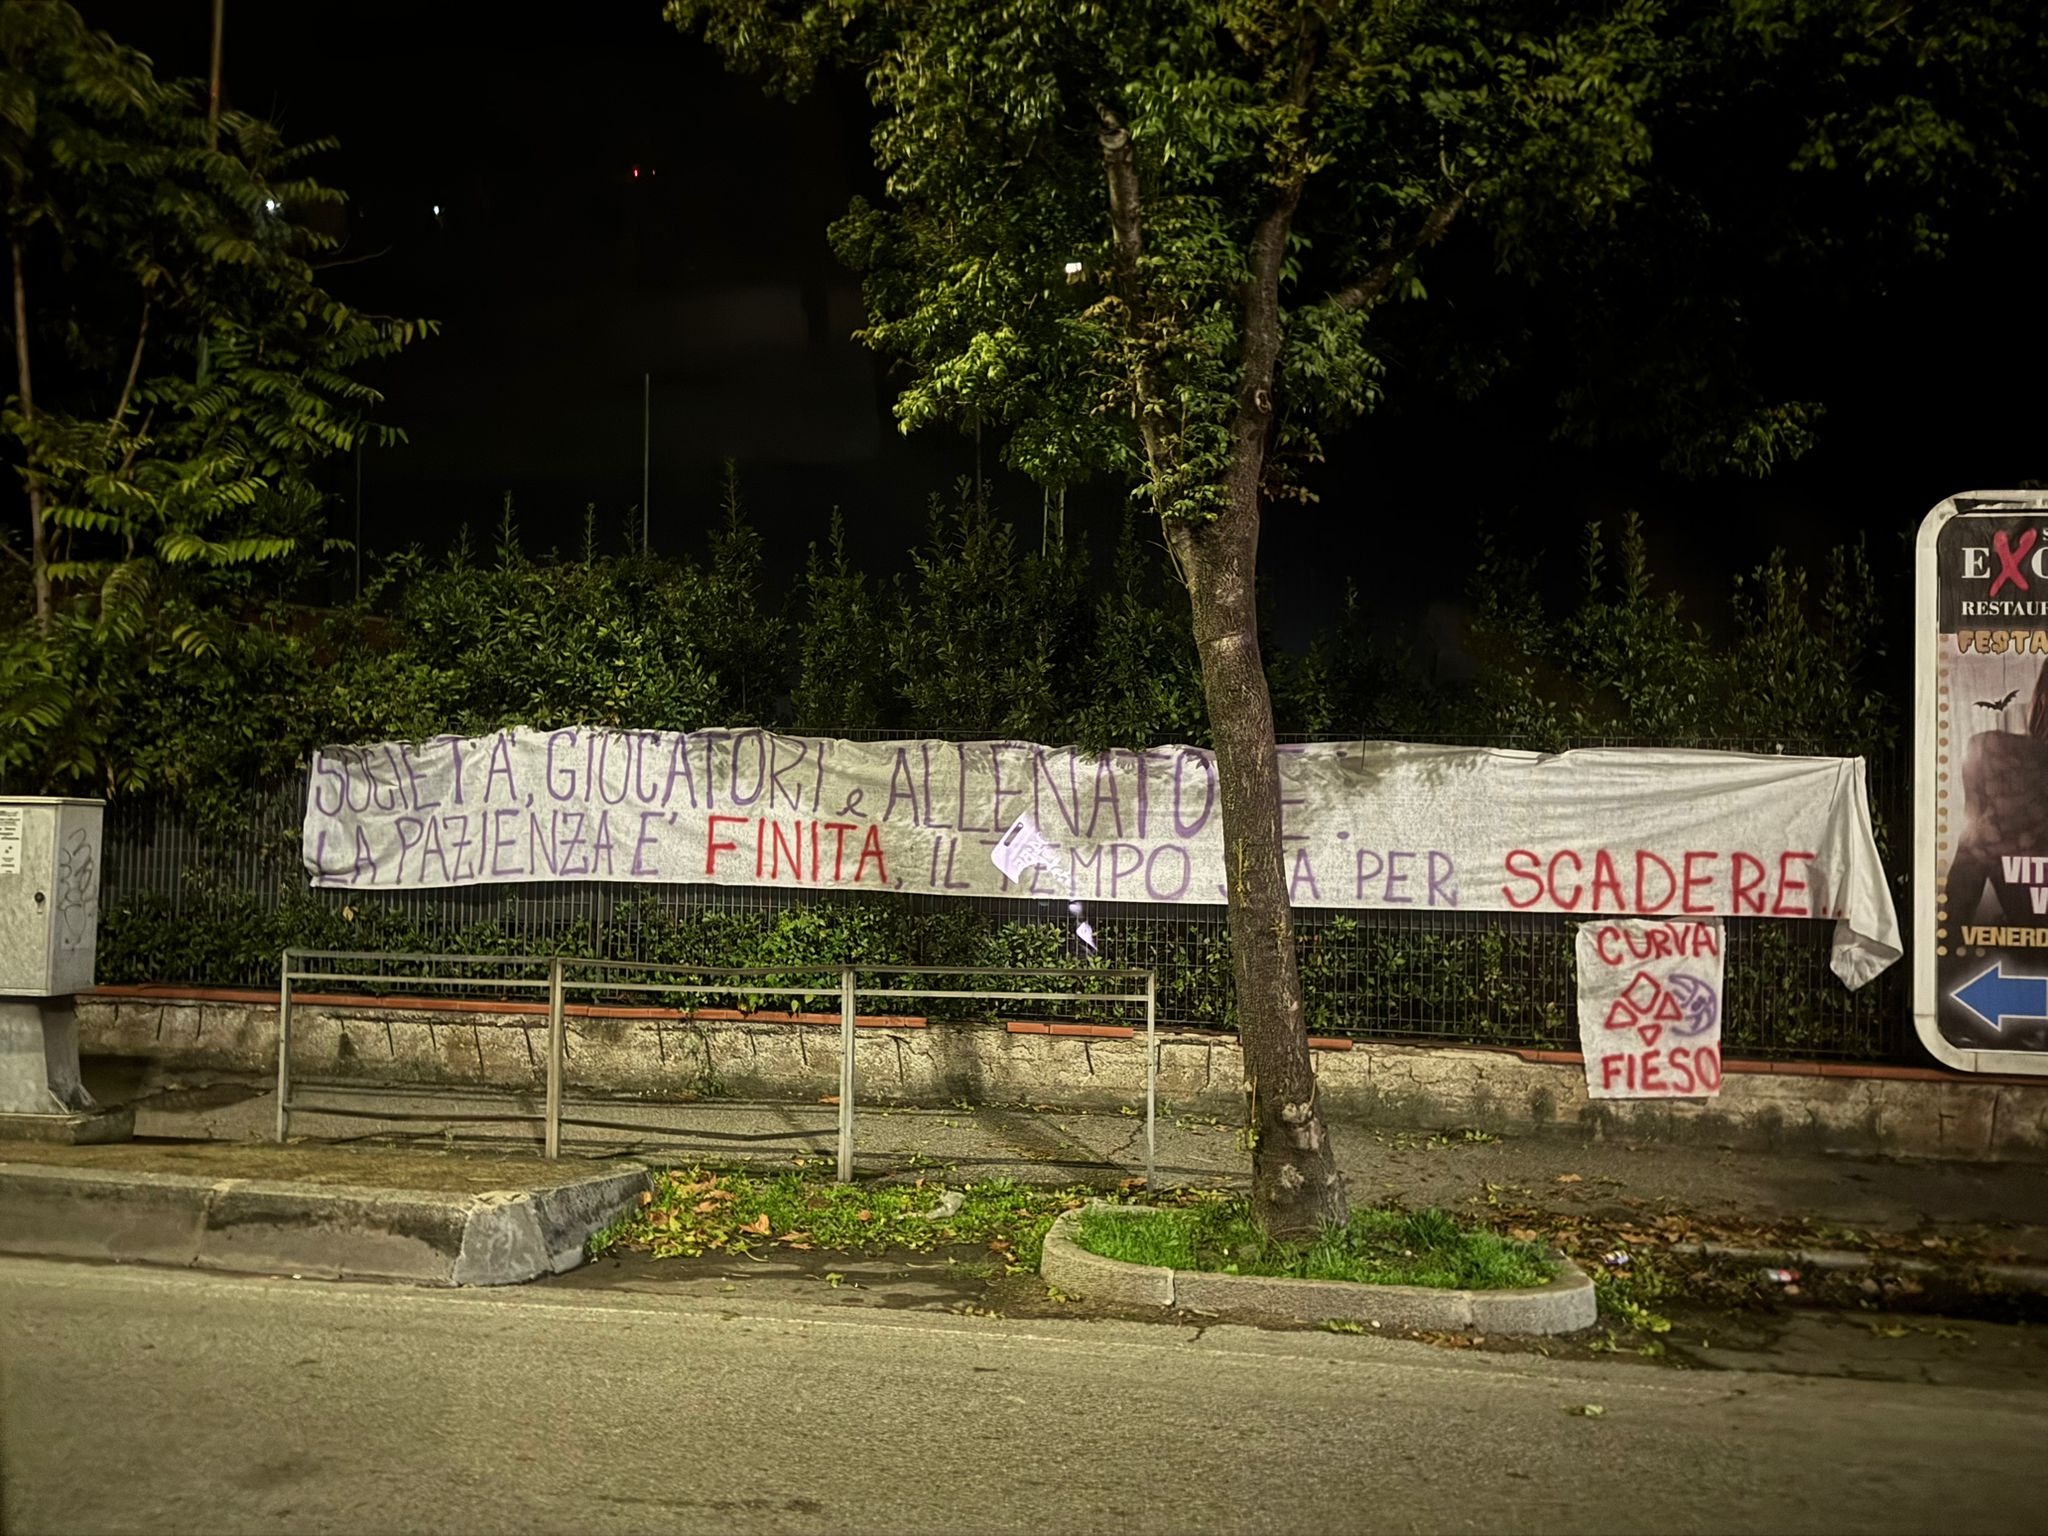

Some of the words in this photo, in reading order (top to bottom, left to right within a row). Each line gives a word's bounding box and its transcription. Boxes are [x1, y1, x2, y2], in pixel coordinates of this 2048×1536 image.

[545, 728, 824, 813] GIOCATORI
[835, 788, 867, 817] e
[316, 820, 378, 884] LA
[395, 808, 614, 885] PAZIENZA
[929, 835, 970, 888] IL
[1355, 848, 1458, 908] PER
[1596, 921, 1719, 966] CURVA
